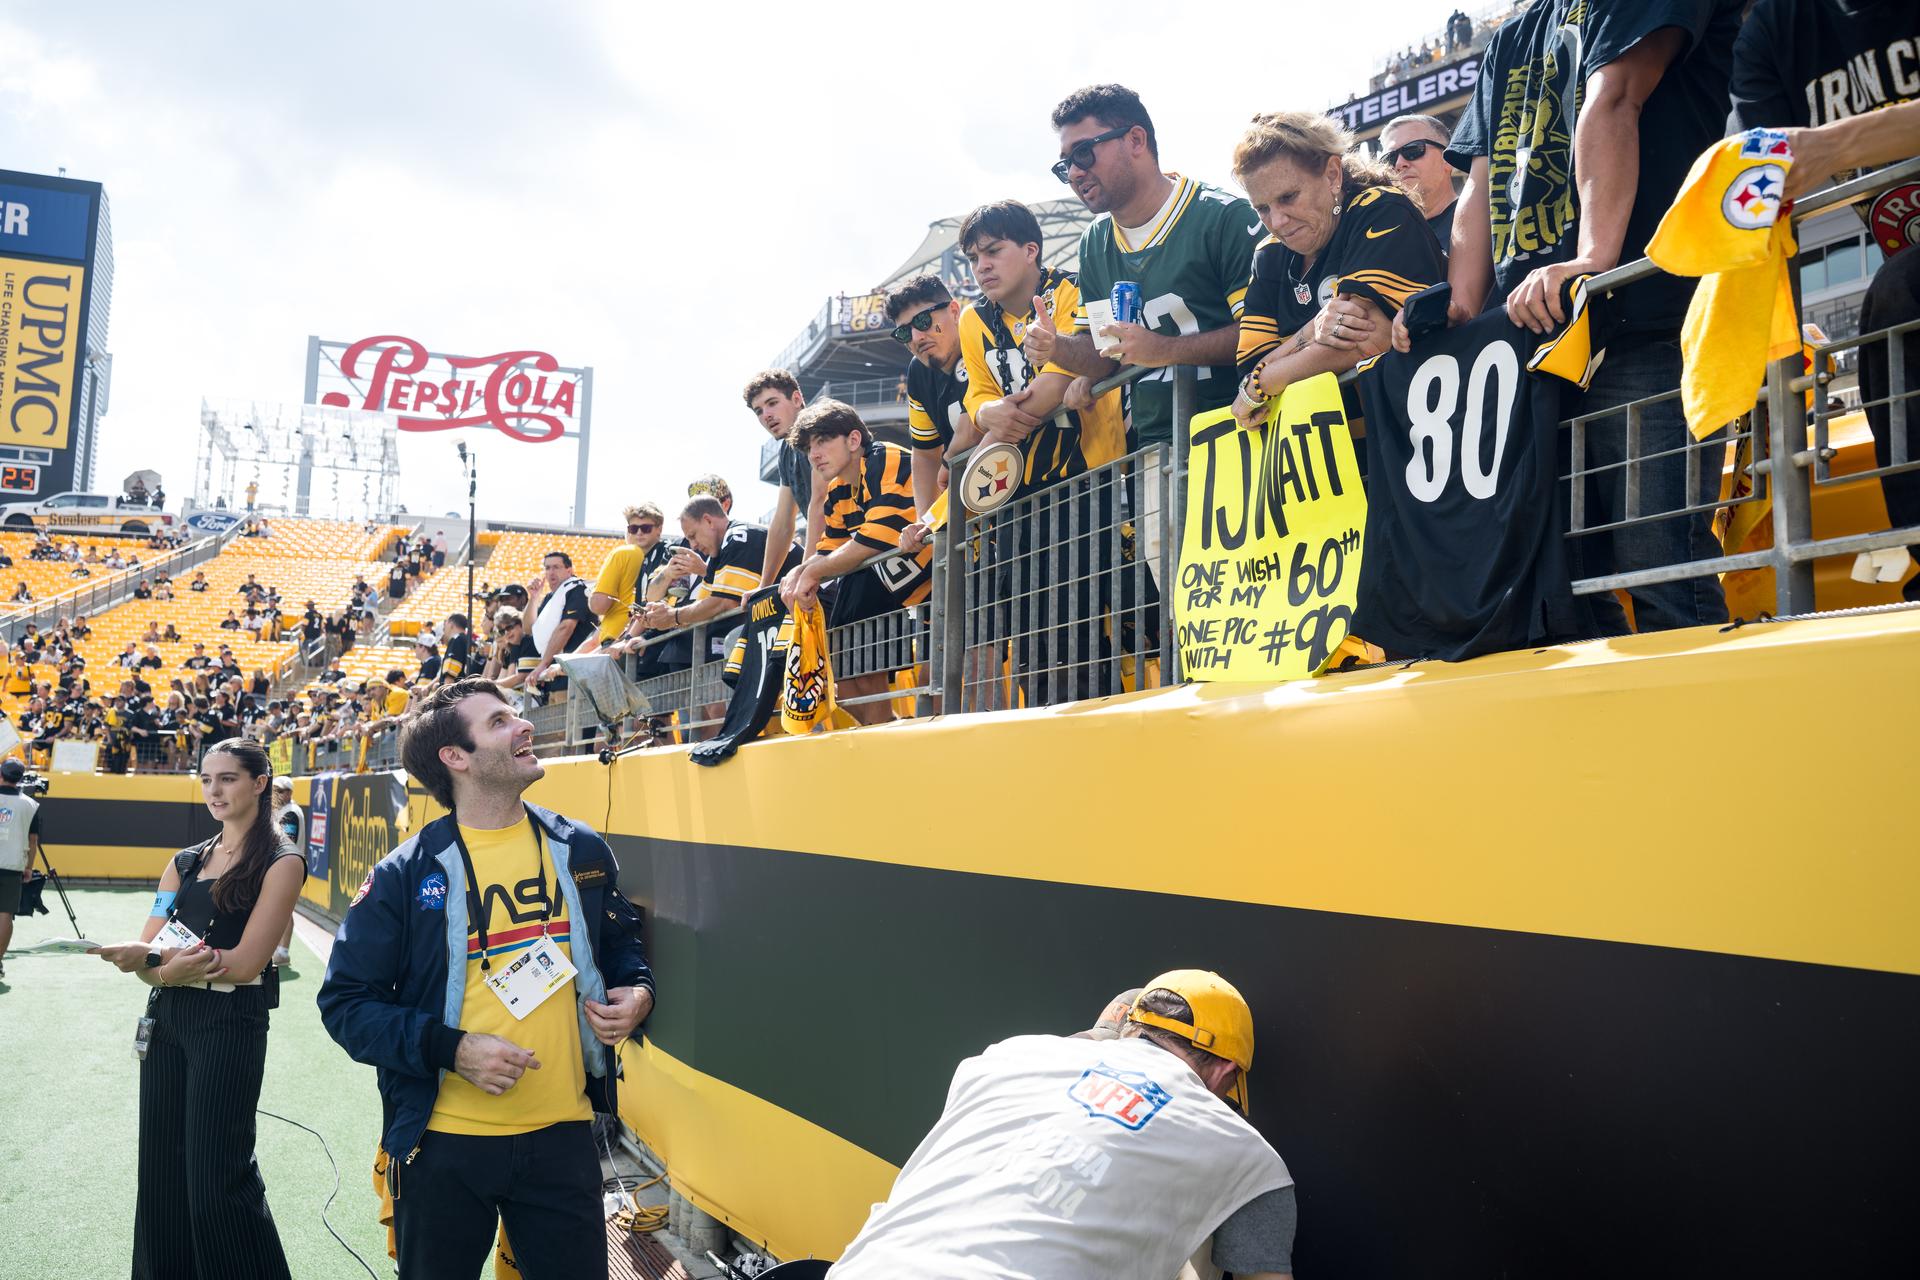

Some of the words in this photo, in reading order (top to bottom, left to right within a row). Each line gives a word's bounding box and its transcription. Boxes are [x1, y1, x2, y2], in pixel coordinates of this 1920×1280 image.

[1805, 49, 1888, 129] IRON
[1887, 38, 1920, 96] C
[0, 202, 30, 236] R
[4, 271, 15, 298] LIFE
[10, 274, 72, 437] UPMC
[1405, 339, 1519, 503] 80
[2, 467, 36, 490] 25
[977, 465, 993, 480] Steelers
[49, 513, 101, 527] Steelers
[196, 515, 236, 532] Ford
[1181, 559, 1229, 590] ONE
[1236, 552, 1281, 584] WISH
[1187, 585, 1222, 612] FOR
[1230, 583, 1267, 609] MY
[1287, 528, 1360, 607] 60th
[1178, 619, 1222, 649] ONE
[1222, 617, 1258, 646] PIC
[1185, 646, 1231, 674] WITH
[1083, 1076, 1144, 1123] NFL
